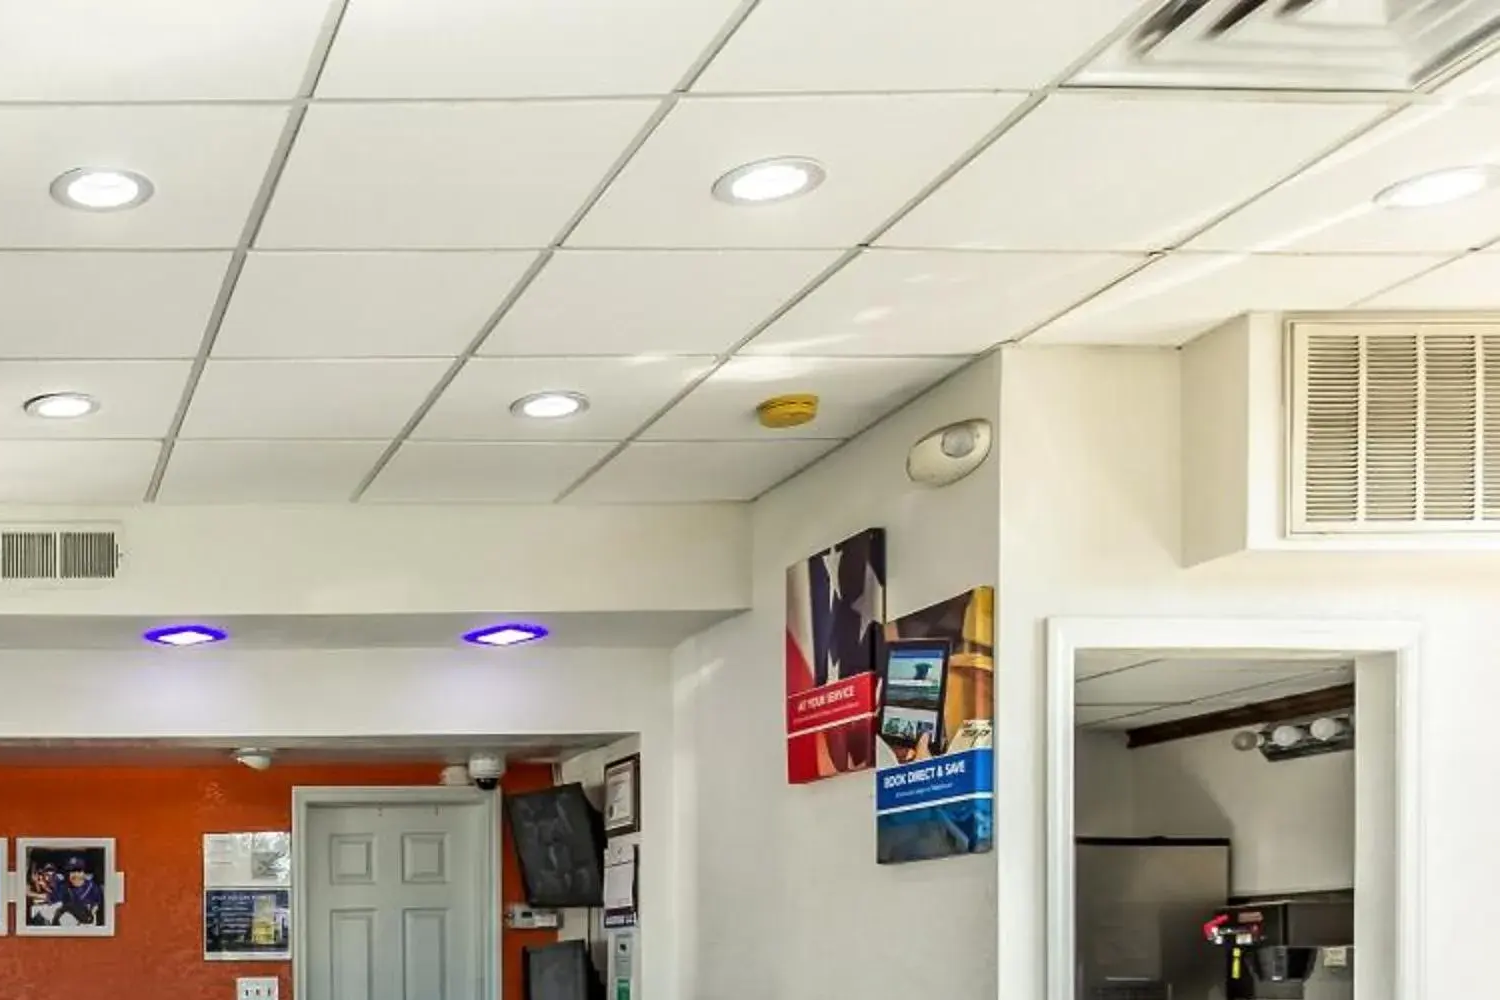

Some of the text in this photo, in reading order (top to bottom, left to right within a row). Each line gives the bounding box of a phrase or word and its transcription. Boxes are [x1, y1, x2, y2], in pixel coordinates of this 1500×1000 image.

[884, 773, 906, 788] BOOK
[908, 767, 935, 783] DIRECT
[945, 760, 965, 775] SAVE
